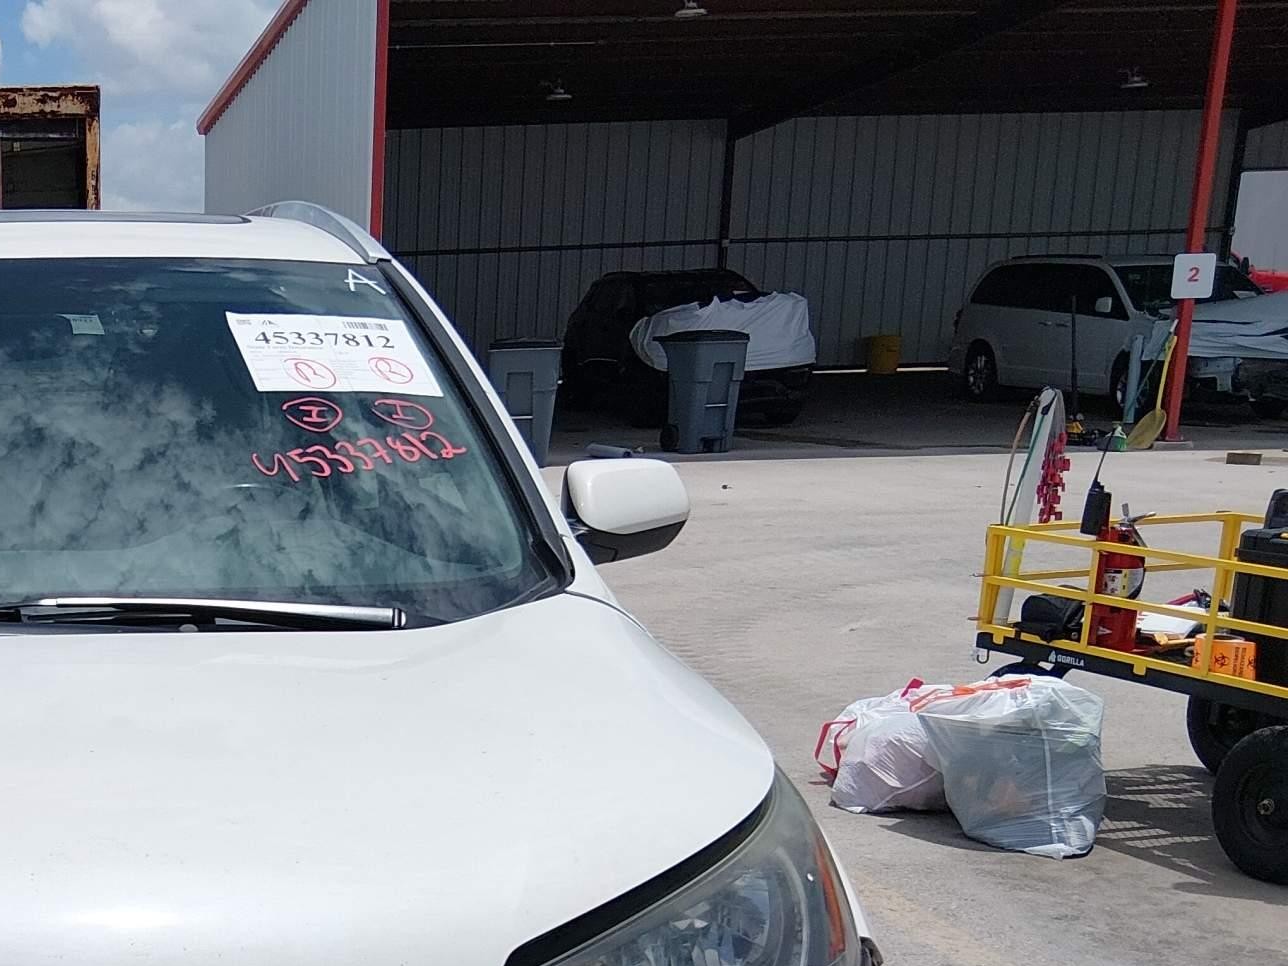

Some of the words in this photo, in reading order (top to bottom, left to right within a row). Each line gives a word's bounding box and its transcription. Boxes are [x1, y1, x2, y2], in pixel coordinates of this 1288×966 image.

[1187, 266, 1200, 282] 2
[254, 331, 395, 349] 45337812
[1056, 654, 1085, 667] GORILLA
